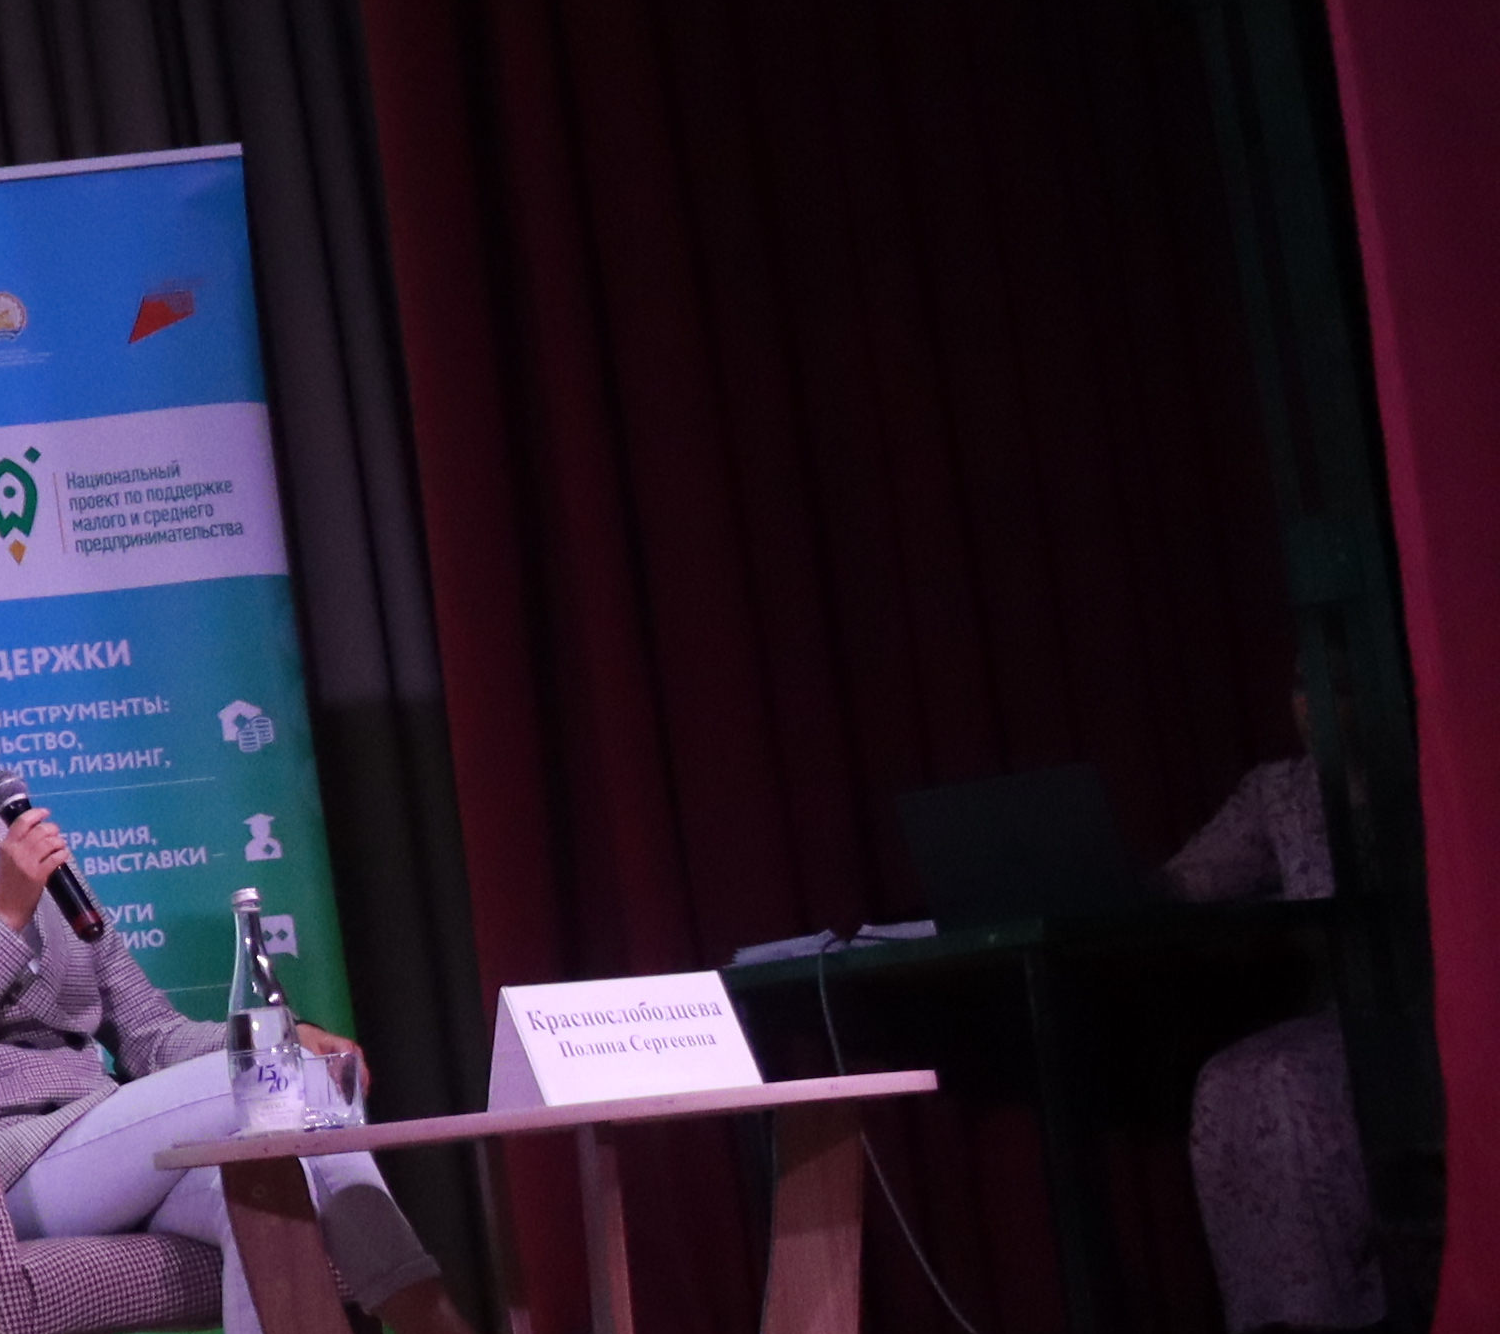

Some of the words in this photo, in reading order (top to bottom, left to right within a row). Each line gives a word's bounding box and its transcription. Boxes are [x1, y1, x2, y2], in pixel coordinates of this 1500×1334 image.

[66, 461, 181, 489] Национальный
[69, 494, 120, 513] проект
[124, 491, 142, 505] по
[146, 479, 233, 503] поддержке
[72, 514, 127, 532] малого
[131, 514, 140, 525] и
[143, 503, 214, 527] среднего
[75, 521, 244, 557] предпринимательства
[69, 748, 171, 774] ЛИЗИНГ,
[84, 846, 208, 876] ВЫСТАВКИ
[526, 1002, 723, 1035] Краснослободцева
[559, 1040, 627, 1058] Полина
[629, 1033, 717, 1054] Сергеевна
